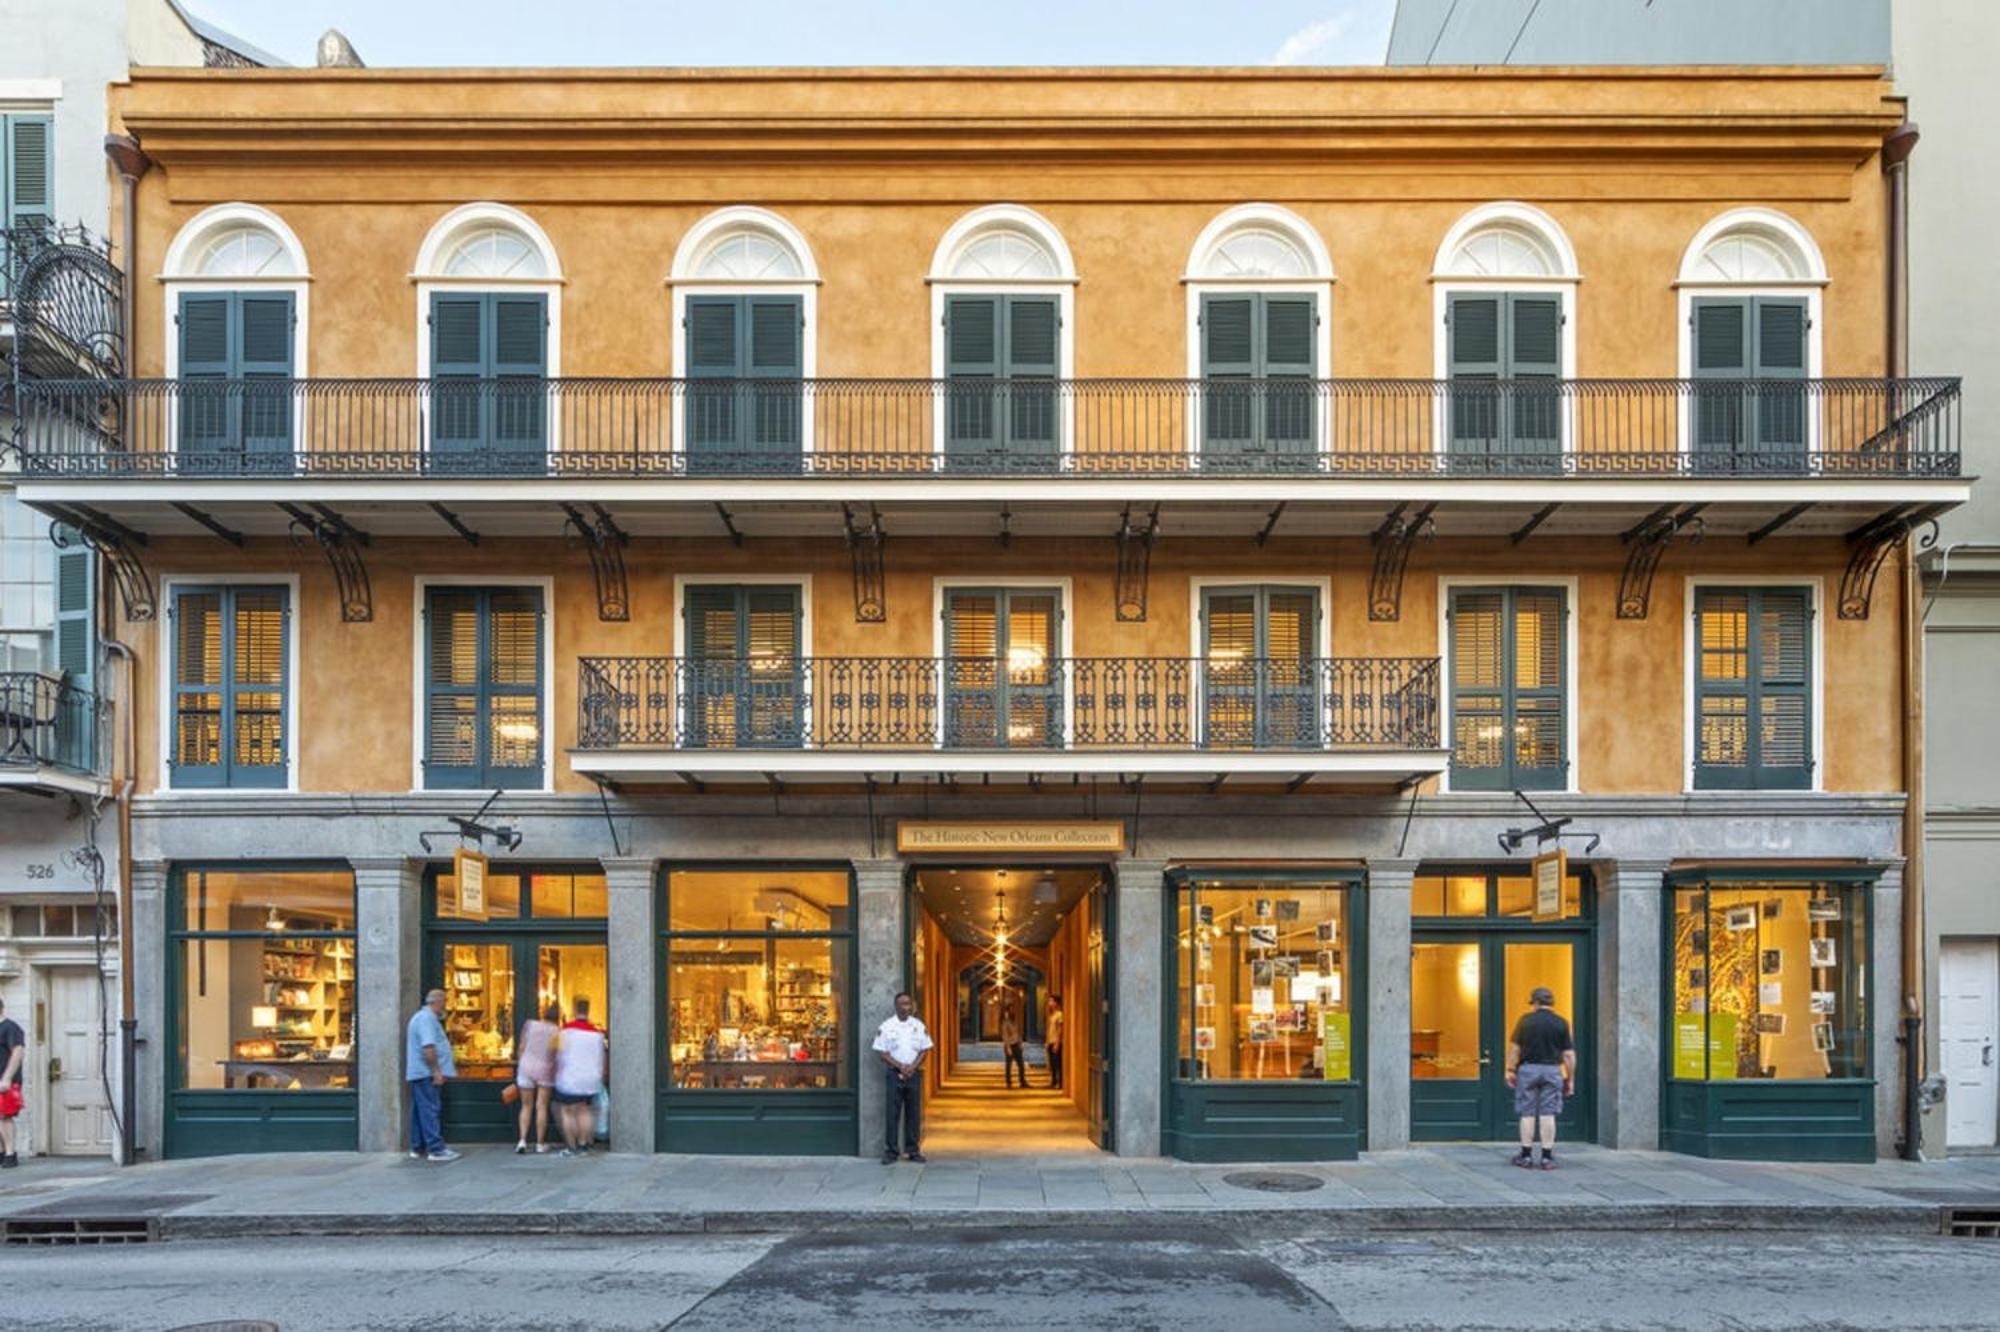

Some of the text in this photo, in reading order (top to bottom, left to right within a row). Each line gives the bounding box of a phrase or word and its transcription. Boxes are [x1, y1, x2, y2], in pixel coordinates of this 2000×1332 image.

[913, 831, 1111, 843] The Historic New Orleans Collection
[26, 864, 55, 879] 526
